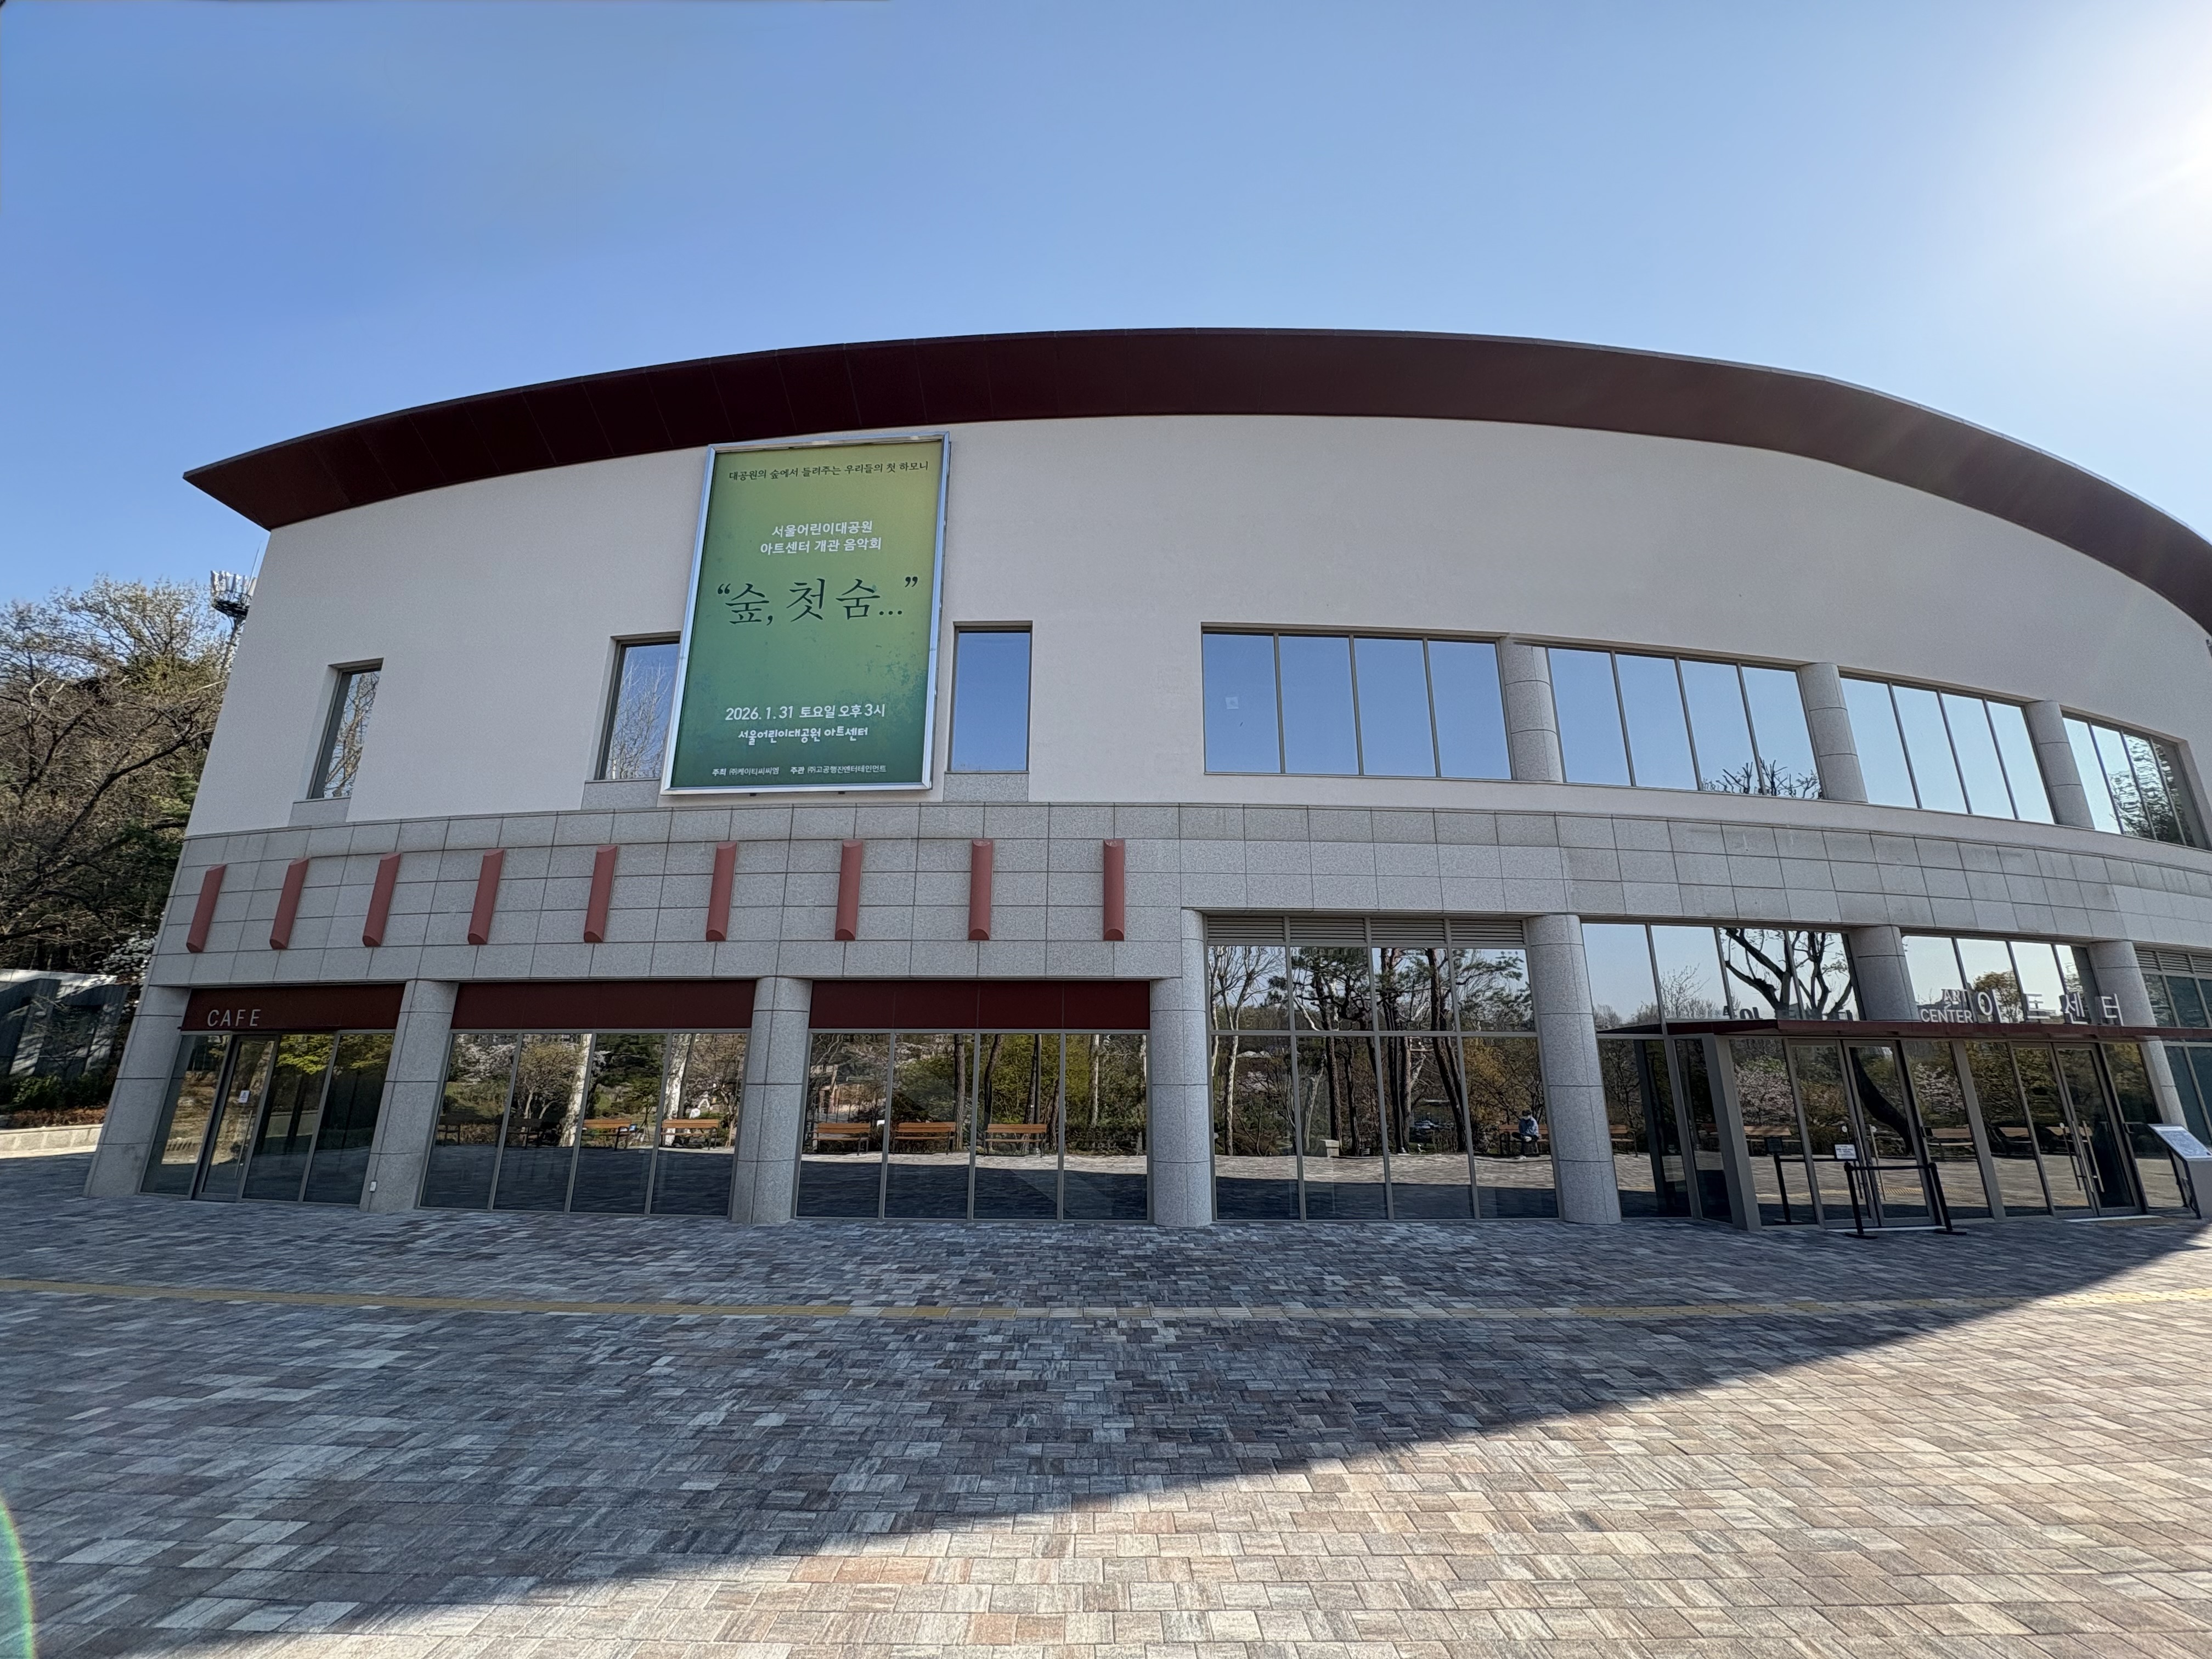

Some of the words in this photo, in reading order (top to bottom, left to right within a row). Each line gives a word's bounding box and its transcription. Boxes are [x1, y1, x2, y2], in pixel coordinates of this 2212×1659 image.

[729, 469, 767, 481] 대공원의
[770, 467, 798, 479] 숲에서
[802, 466, 842, 477] 들려주는
[844, 464, 883, 474] 우리들의
[886, 462, 896, 473] 첫
[899, 460, 929, 471] 하모니
[771, 520, 873, 538] 서울어린이대공원
[760, 540, 810, 555] 아트센터
[814, 539, 840, 552] 개관
[843, 537, 882, 551] 음악회
[786, 578, 826, 623] 첫
[799, 706, 836, 719] 토요일
[838, 704, 862, 718] 오후
[864, 703, 885, 717] 3시
[737, 727, 821, 746] 서울어린이대공원
[824, 726, 868, 741] 아트센터
[1943, 989, 1970, 1004] ART
[1920, 1008, 1974, 1024] CENTER
[1977, 989, 2124, 1026] 아트센터
[207, 1009, 261, 1027] CAFE
